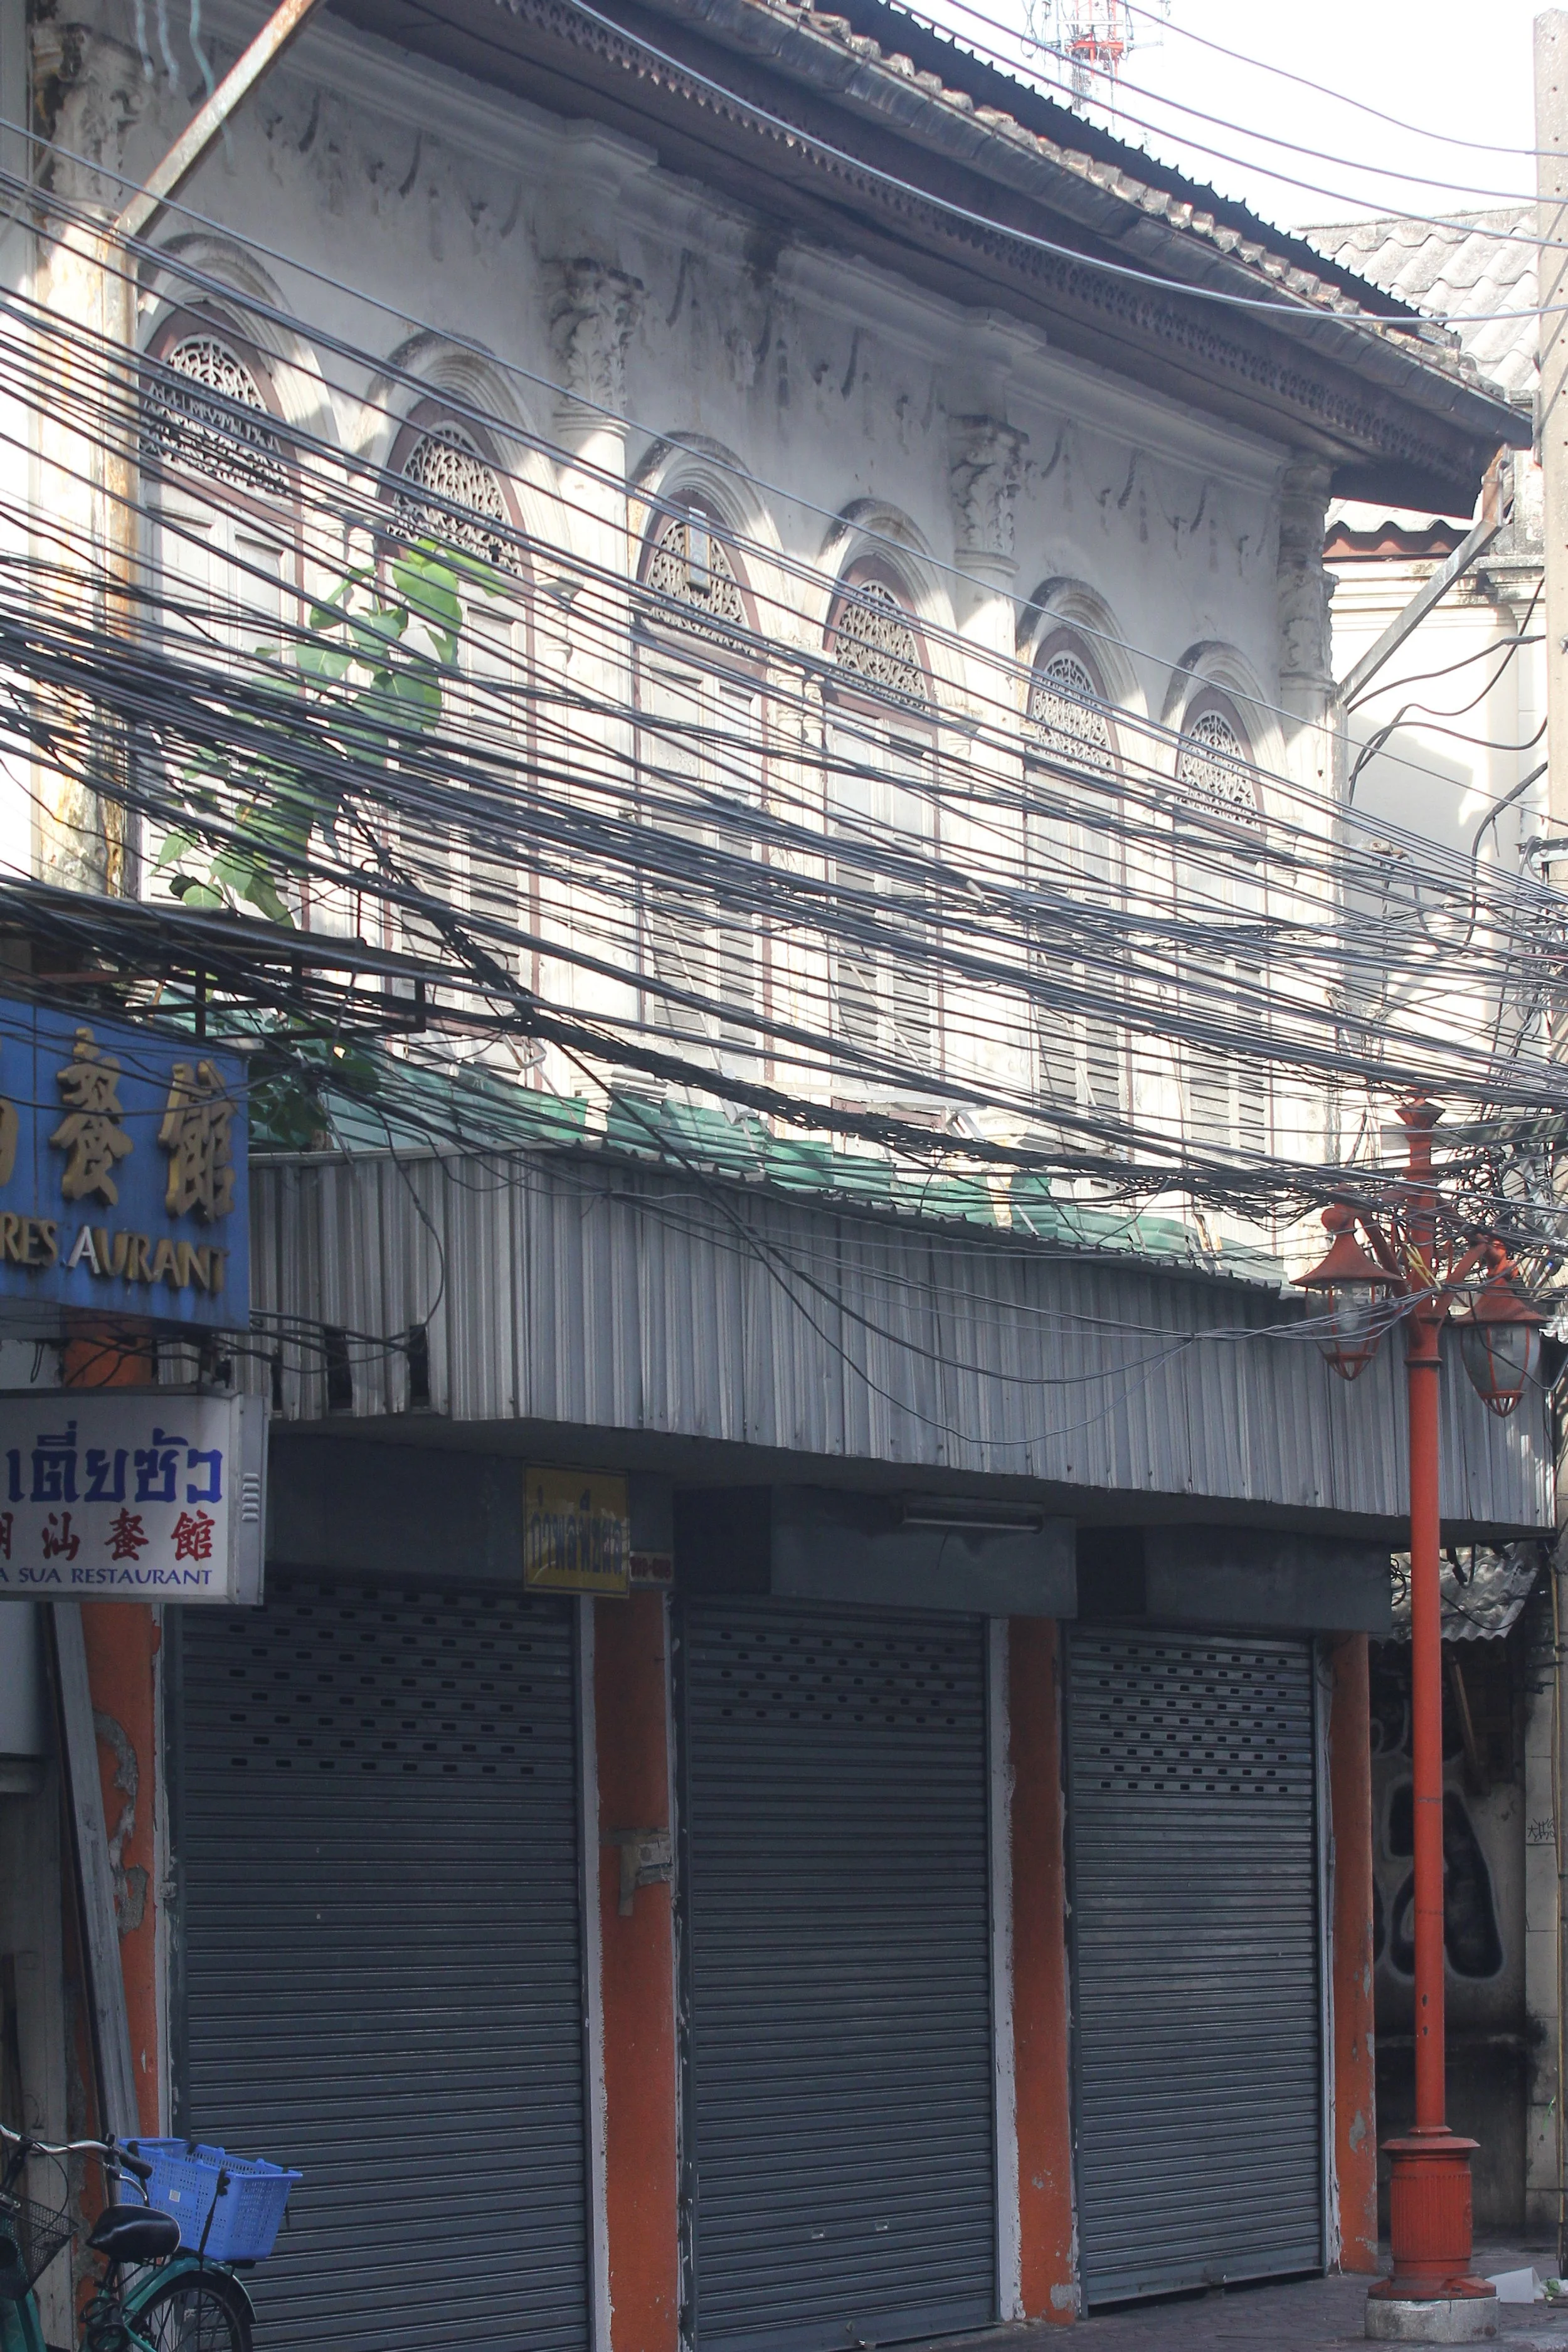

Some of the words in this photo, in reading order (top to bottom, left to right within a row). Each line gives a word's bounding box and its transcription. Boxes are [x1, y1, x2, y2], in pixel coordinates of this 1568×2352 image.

[0, 1027, 238, 1223] 餐館
[19, 1567, 62, 1583] SUA
[71, 1568, 213, 1585] RESTAURANT
